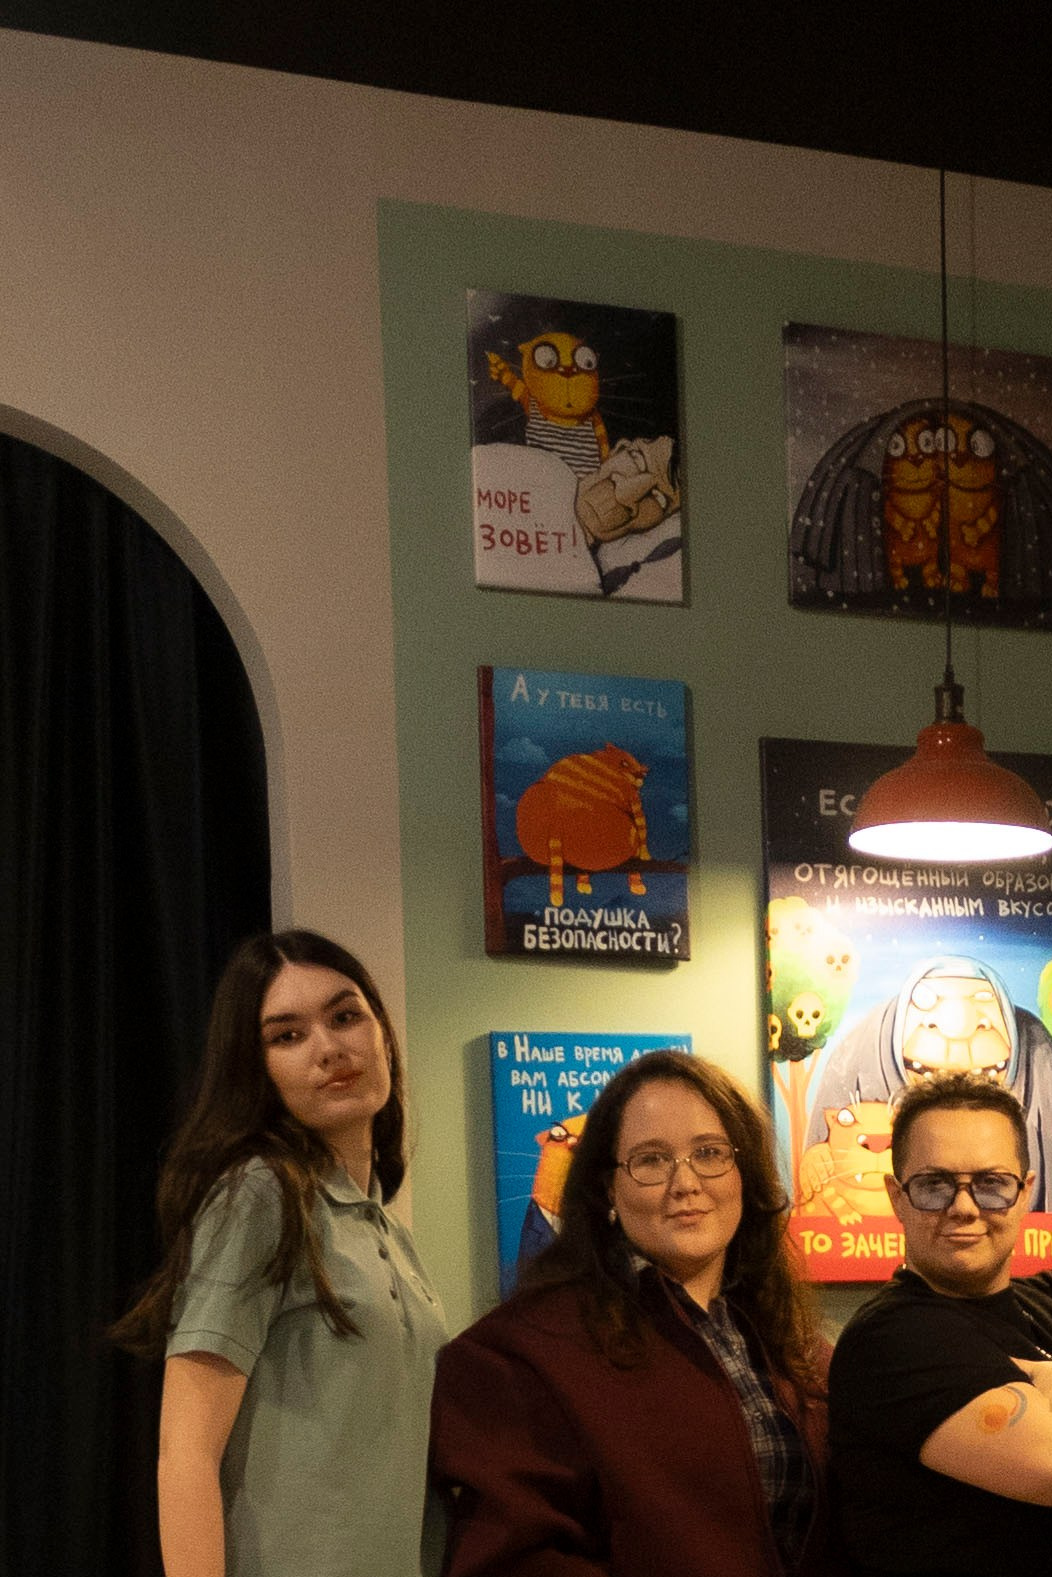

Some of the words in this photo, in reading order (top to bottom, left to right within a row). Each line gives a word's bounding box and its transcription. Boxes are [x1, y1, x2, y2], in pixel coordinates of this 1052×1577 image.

[477, 487, 531, 514] МОРЕ
[479, 522, 577, 558] ЗОВЁТ!
[511, 673, 530, 703] А
[556, 690, 609, 711] ТЕБЯ
[620, 697, 668, 719] ЕСТЬ
[819, 789, 857, 816] ЕС
[544, 906, 650, 930] ПОДУШКА
[855, 896, 984, 918] ИЗЫСКАННЫМ
[523, 923, 682, 954] БЕЗОПАСНОСТИ?
[574, 1046, 624, 1067] ВРЕМЯ
[511, 1069, 547, 1087] ВАМ
[557, 1070, 616, 1088] АБСОЛ
[522, 1089, 552, 1116] НИ
[567, 1091, 582, 1112] К
[800, 1230, 833, 1254] ТО
